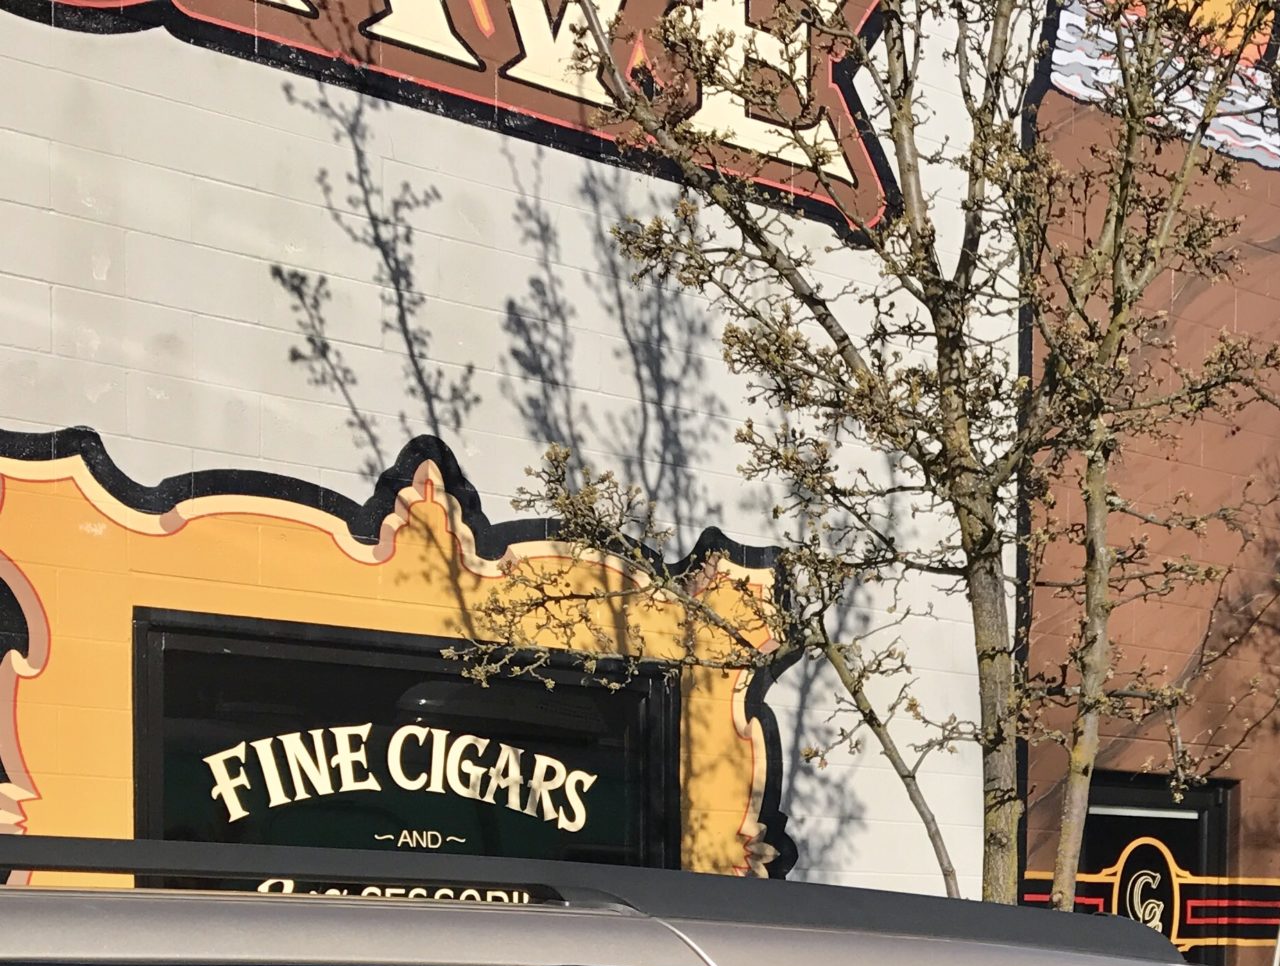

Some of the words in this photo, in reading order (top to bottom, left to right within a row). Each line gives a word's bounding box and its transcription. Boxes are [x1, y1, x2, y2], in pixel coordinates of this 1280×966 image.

[202, 723, 381, 823] FINE
[386, 725, 598, 832] CIGARS
[397, 829, 442, 849] AND
